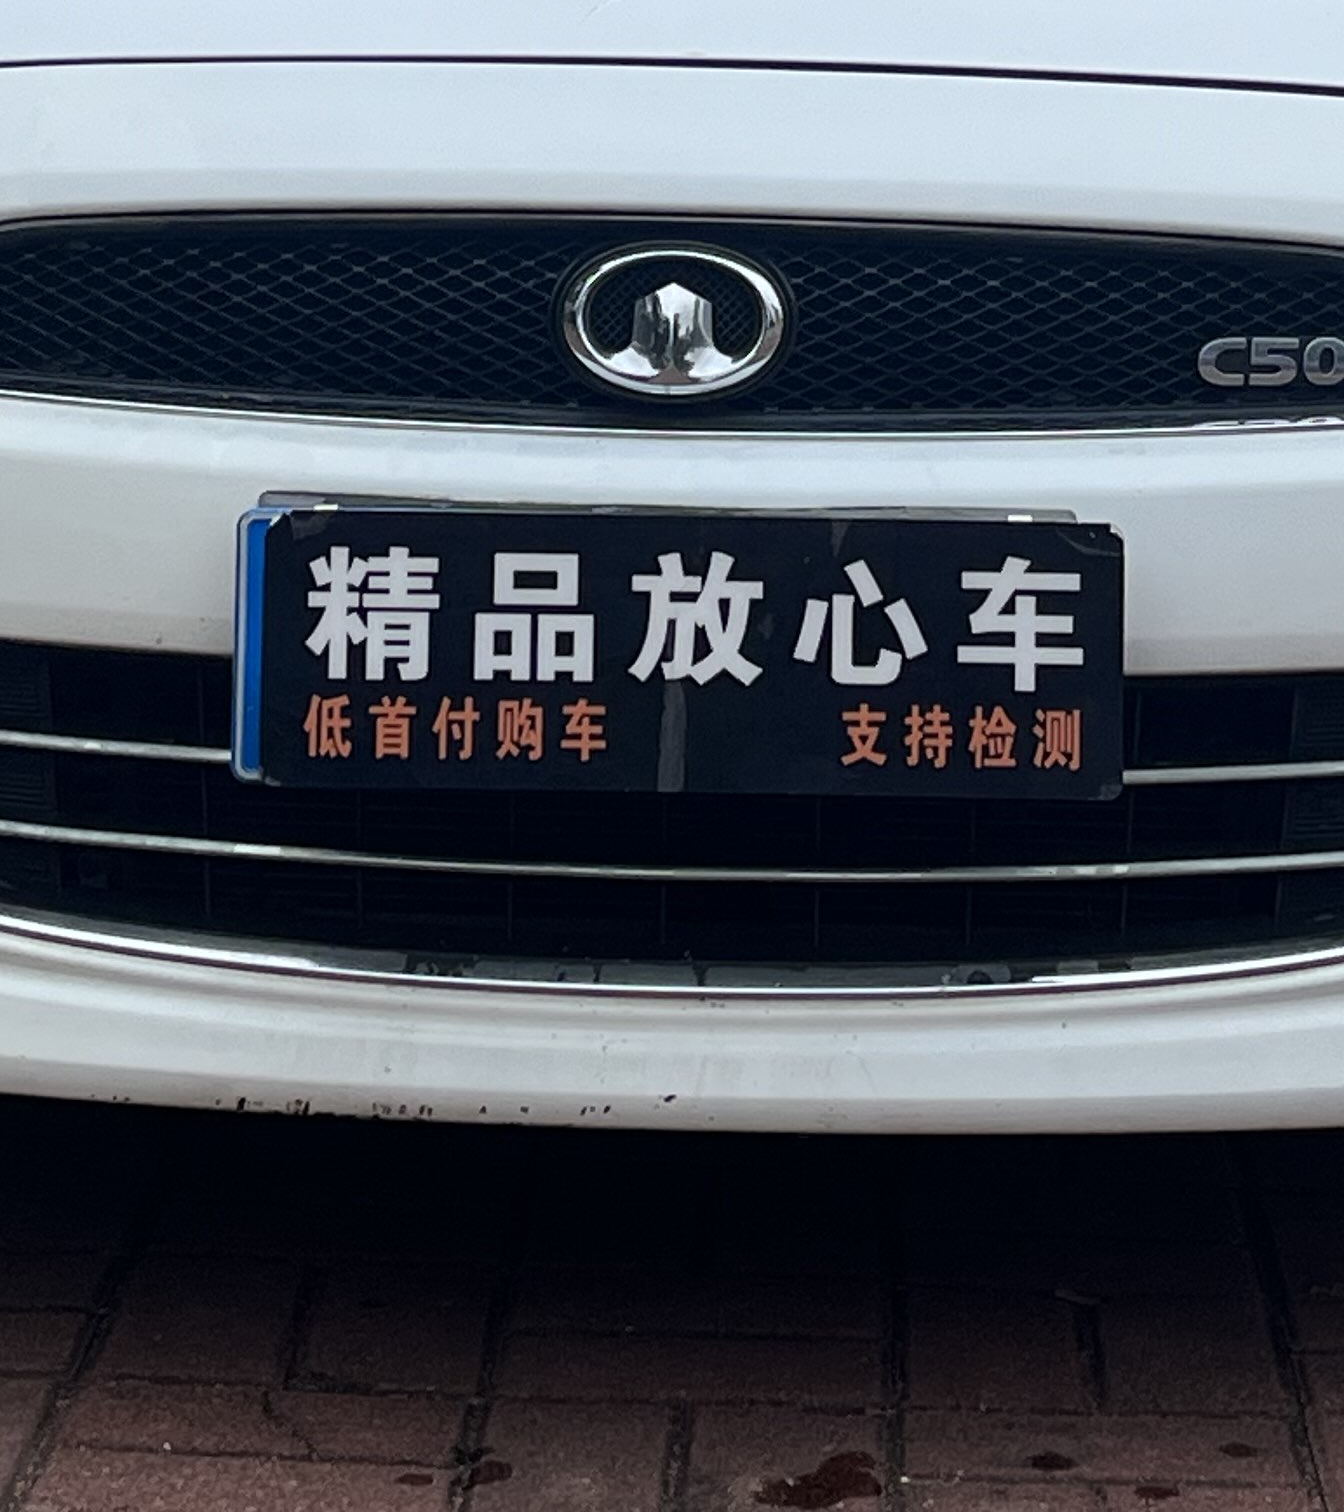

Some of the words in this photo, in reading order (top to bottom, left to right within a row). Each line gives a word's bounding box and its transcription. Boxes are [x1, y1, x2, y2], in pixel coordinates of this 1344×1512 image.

[305, 545, 1085, 693] 精品放心车
[302, 694, 609, 763] 低首付购车
[841, 703, 1084, 773] 支持检测
